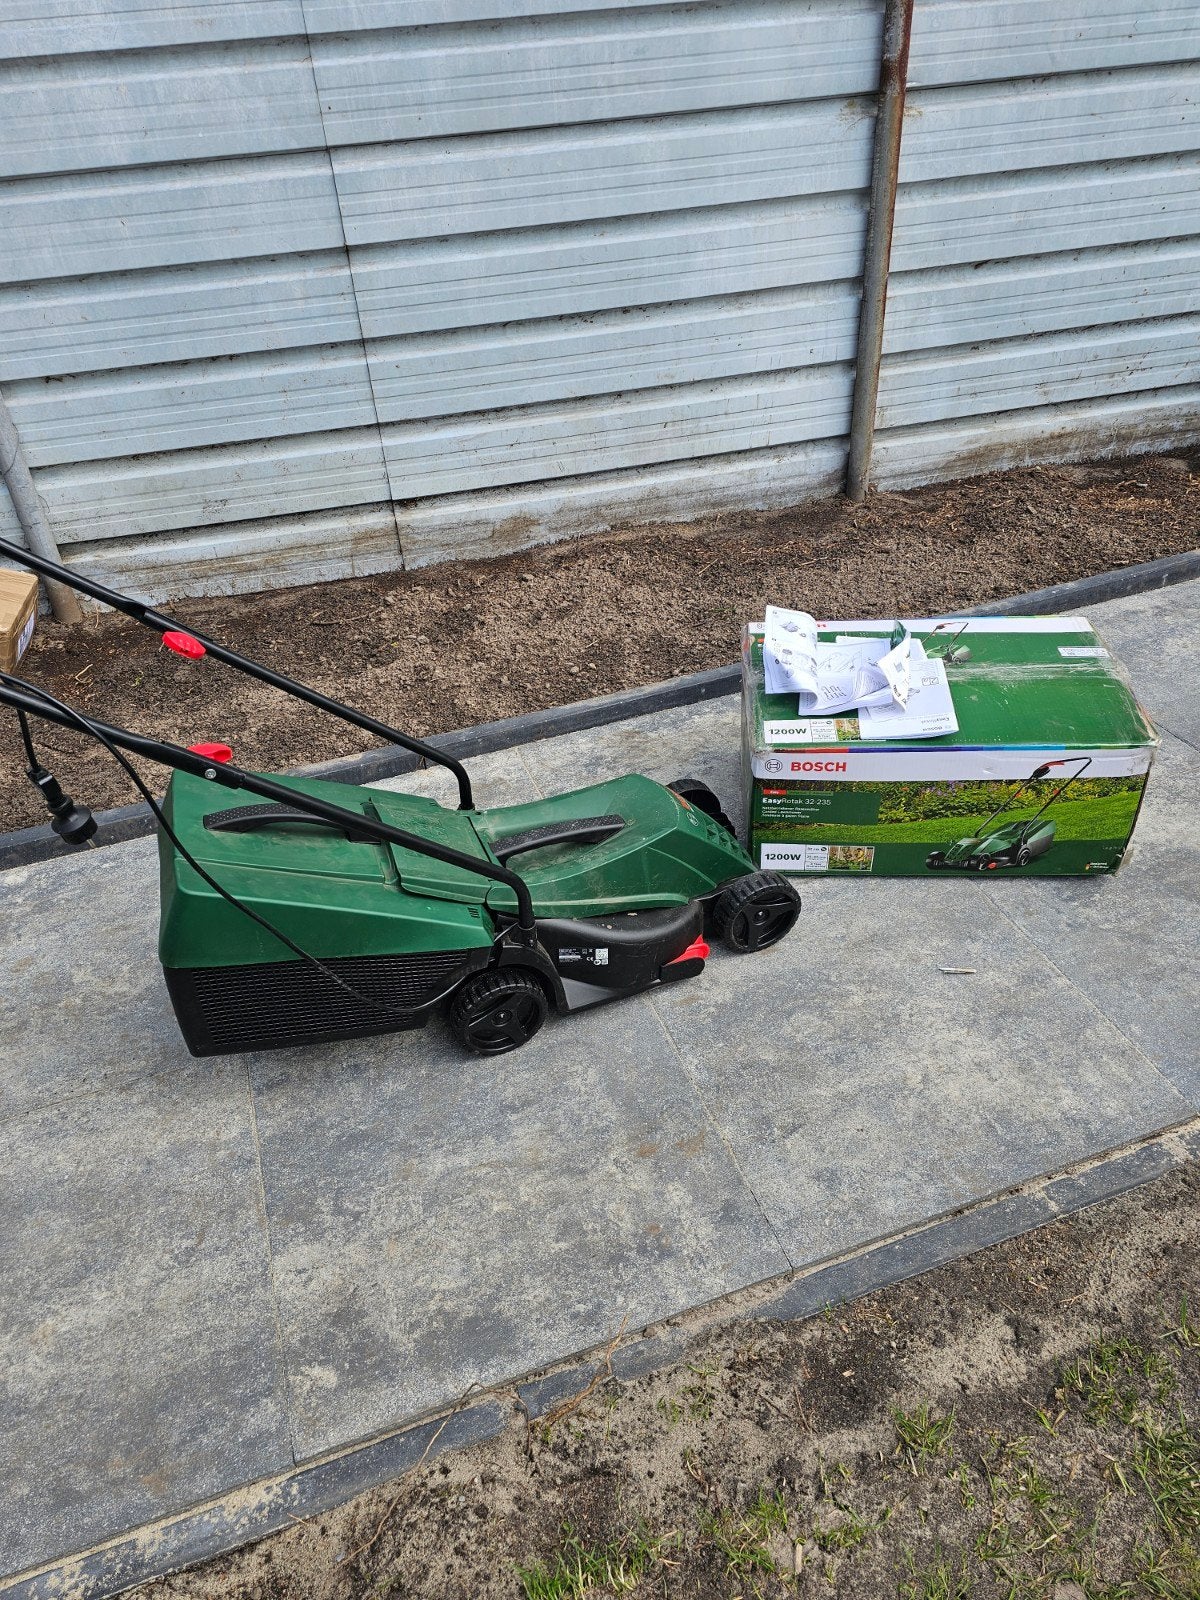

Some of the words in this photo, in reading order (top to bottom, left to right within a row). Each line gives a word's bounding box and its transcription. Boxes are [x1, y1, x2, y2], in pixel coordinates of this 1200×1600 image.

[790, 761, 847, 772] BOSCH
[762, 797, 803, 805] EasyRotak
[764, 853, 802, 861] 1200W
